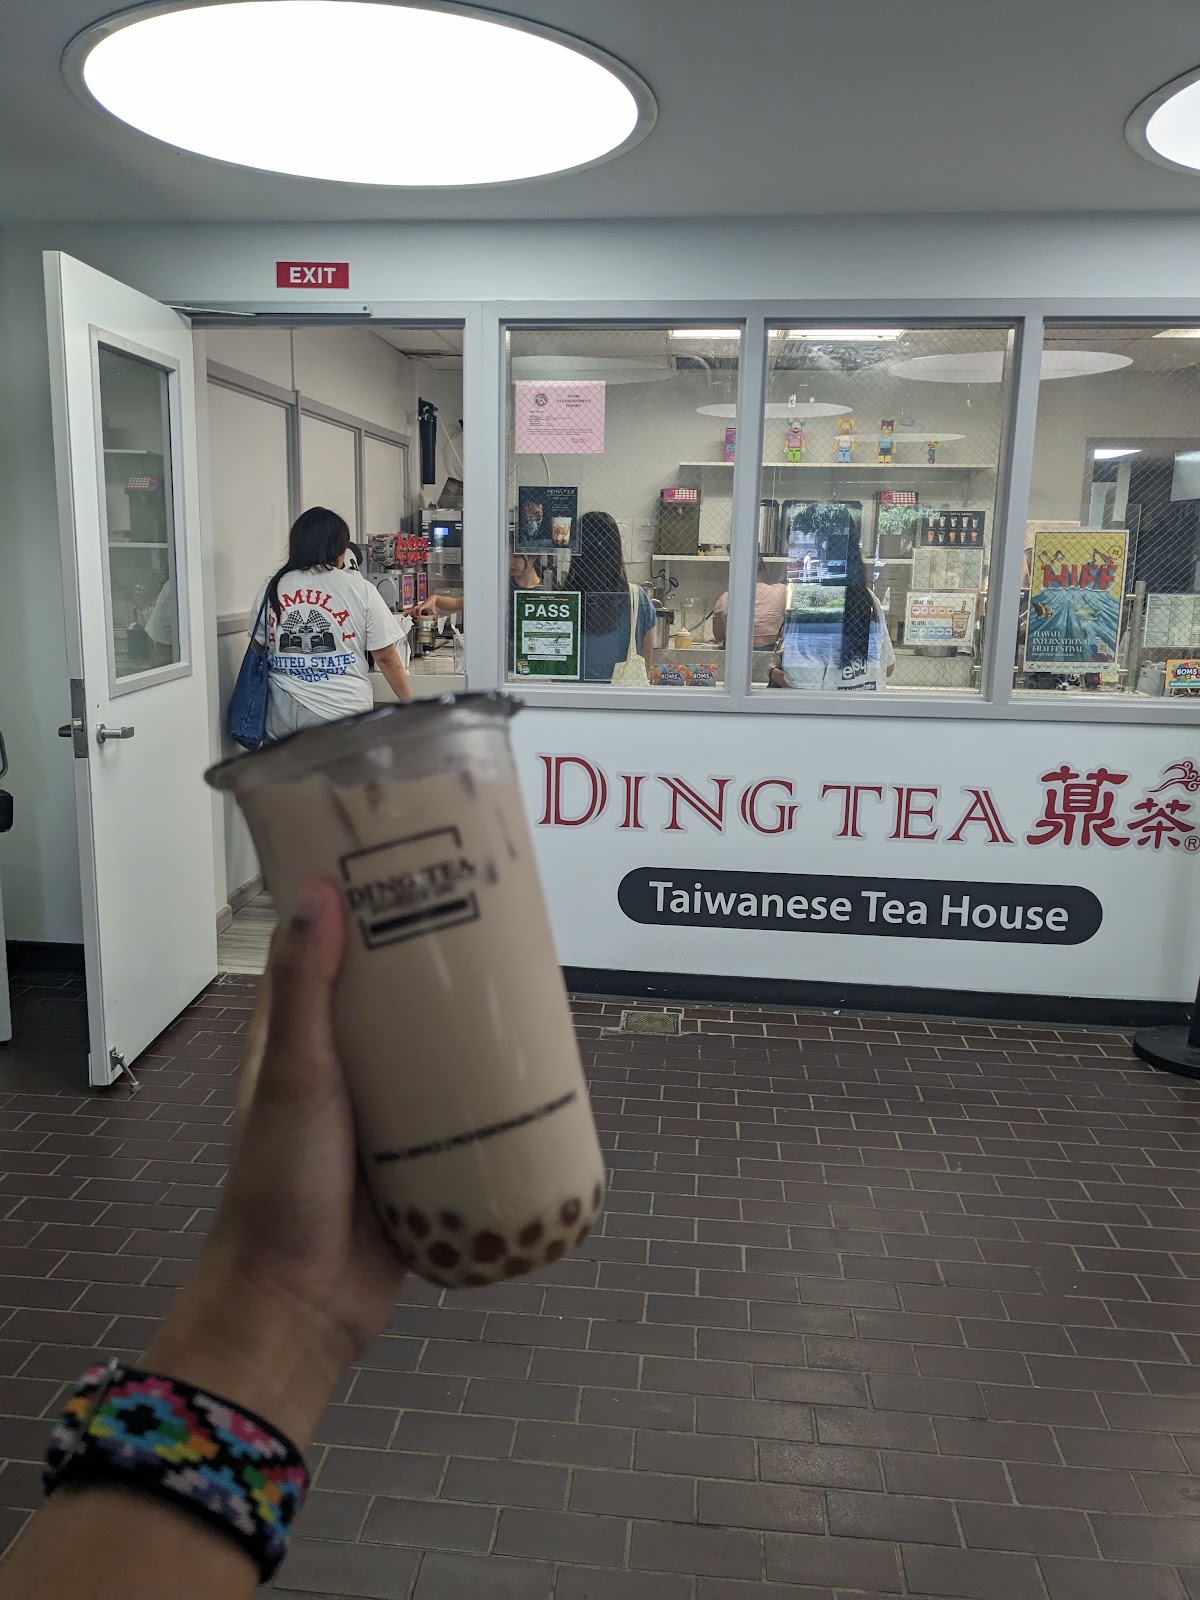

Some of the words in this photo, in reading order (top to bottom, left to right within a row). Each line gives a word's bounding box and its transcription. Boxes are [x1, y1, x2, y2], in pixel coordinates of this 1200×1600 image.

[289, 266, 336, 284] EXIT
[1041, 564, 1117, 590] HIFF
[525, 604, 570, 618] PASS
[271, 656, 305, 668] NITED
[311, 654, 356, 668] STATES
[1177, 668, 1198, 676] NOMS
[538, 755, 799, 834] DING
[821, 783, 1014, 844] TEA
[649, 880, 853, 923] Taiwanese
[861, 890, 928, 926] Tea
[941, 894, 1069, 932] House
